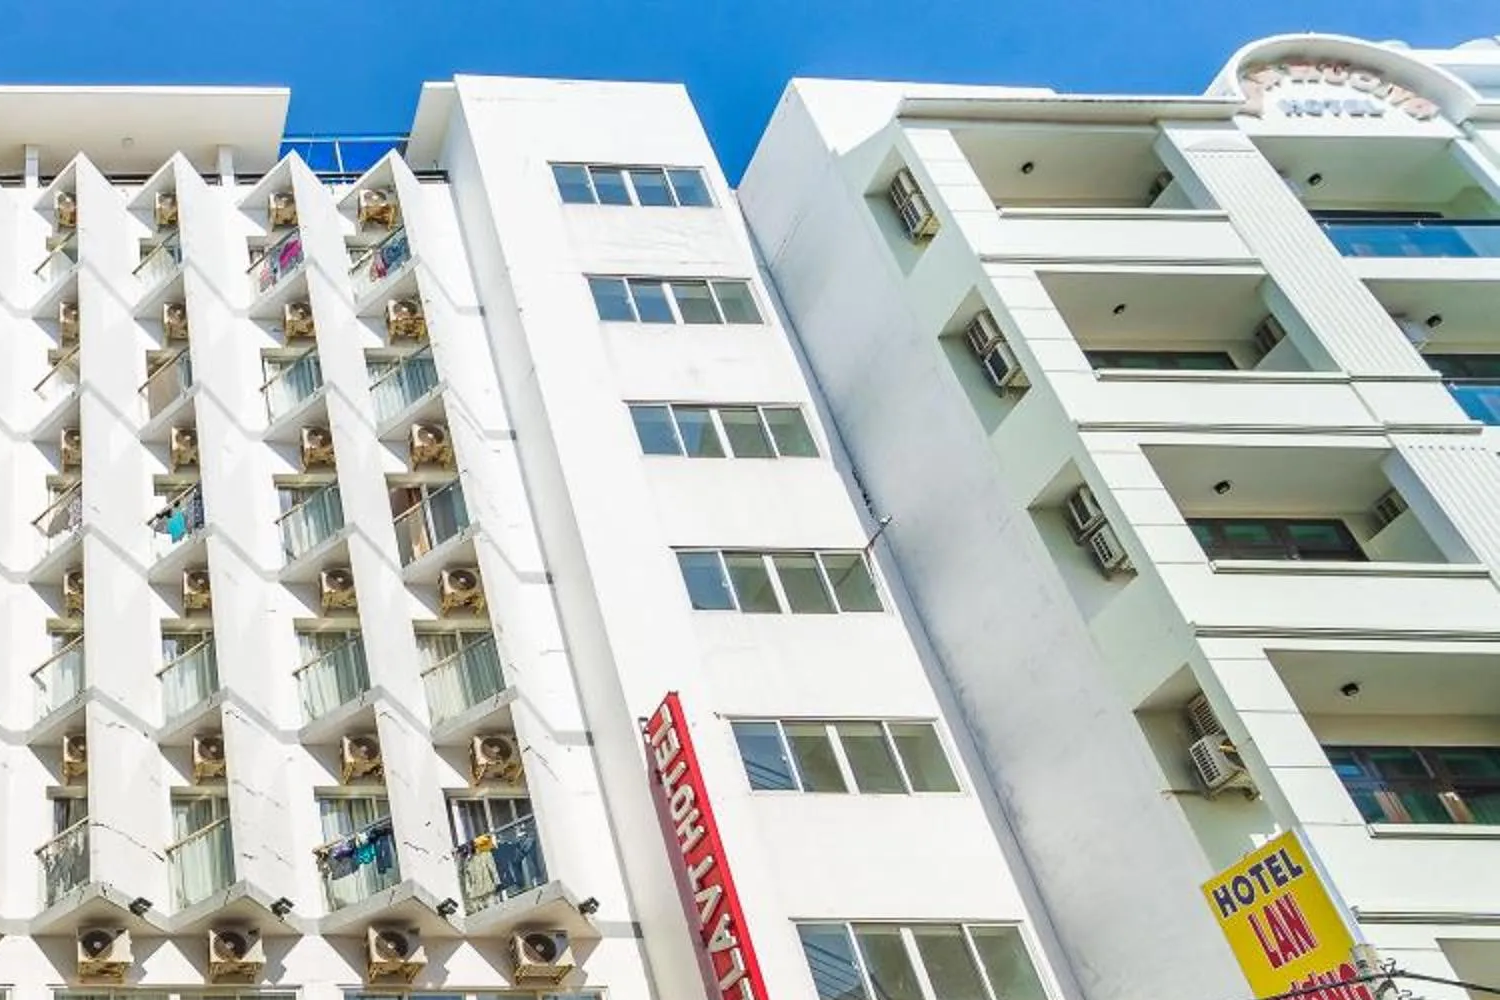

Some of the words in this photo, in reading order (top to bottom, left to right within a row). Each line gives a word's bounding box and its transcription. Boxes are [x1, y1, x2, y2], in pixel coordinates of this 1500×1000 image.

[652, 703, 705, 854] HOTEL
[1211, 848, 1304, 918] HOTEL
[1247, 891, 1320, 970] LAN
